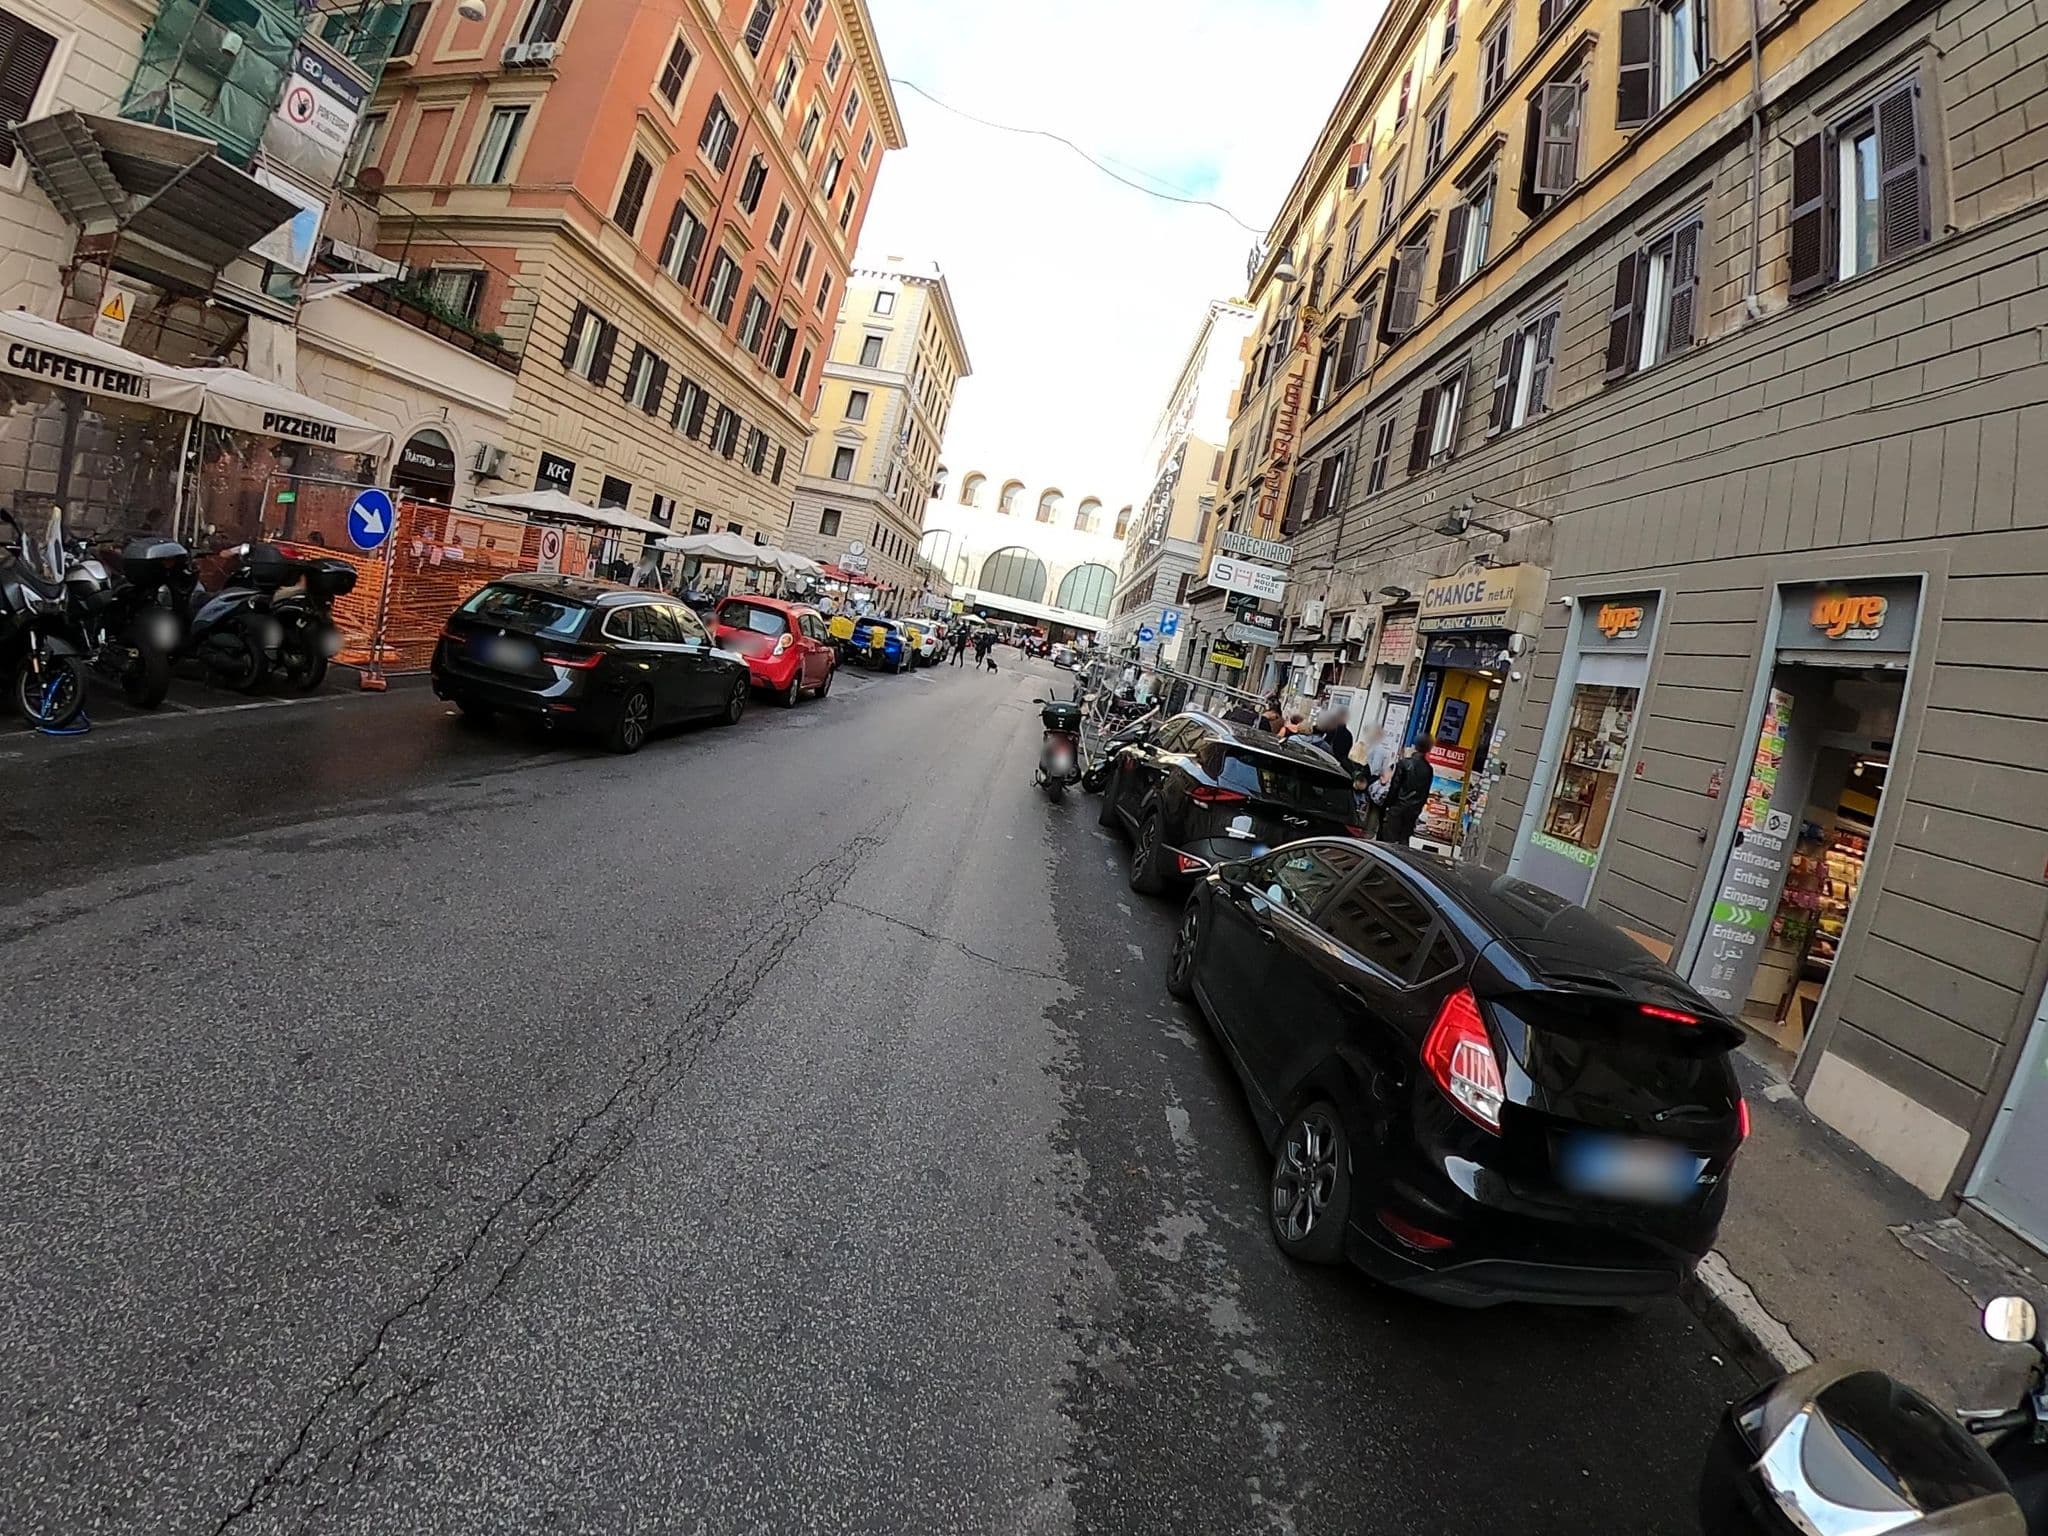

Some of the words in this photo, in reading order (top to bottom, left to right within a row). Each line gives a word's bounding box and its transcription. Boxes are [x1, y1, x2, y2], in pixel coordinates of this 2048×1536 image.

[262, 412, 337, 444] PIZZERIA
[546, 462, 571, 482] KFC
[1223, 533, 1292, 563] MARECHIARO
[1253, 585, 1275, 594] HOTEL
[1254, 578, 1280, 589] HOUSE
[1425, 580, 1487, 608] CHANGE
[1487, 587, 1515, 601] net.it
[1165, 611, 1178, 624] P
[1530, 831, 1593, 865] SUPERMARKET
[1743, 829, 1782, 851] Entrata
[1733, 848, 1781, 871] Entrance
[1722, 886, 1769, 911] Eingang
[1712, 924, 1756, 945] Entrada
